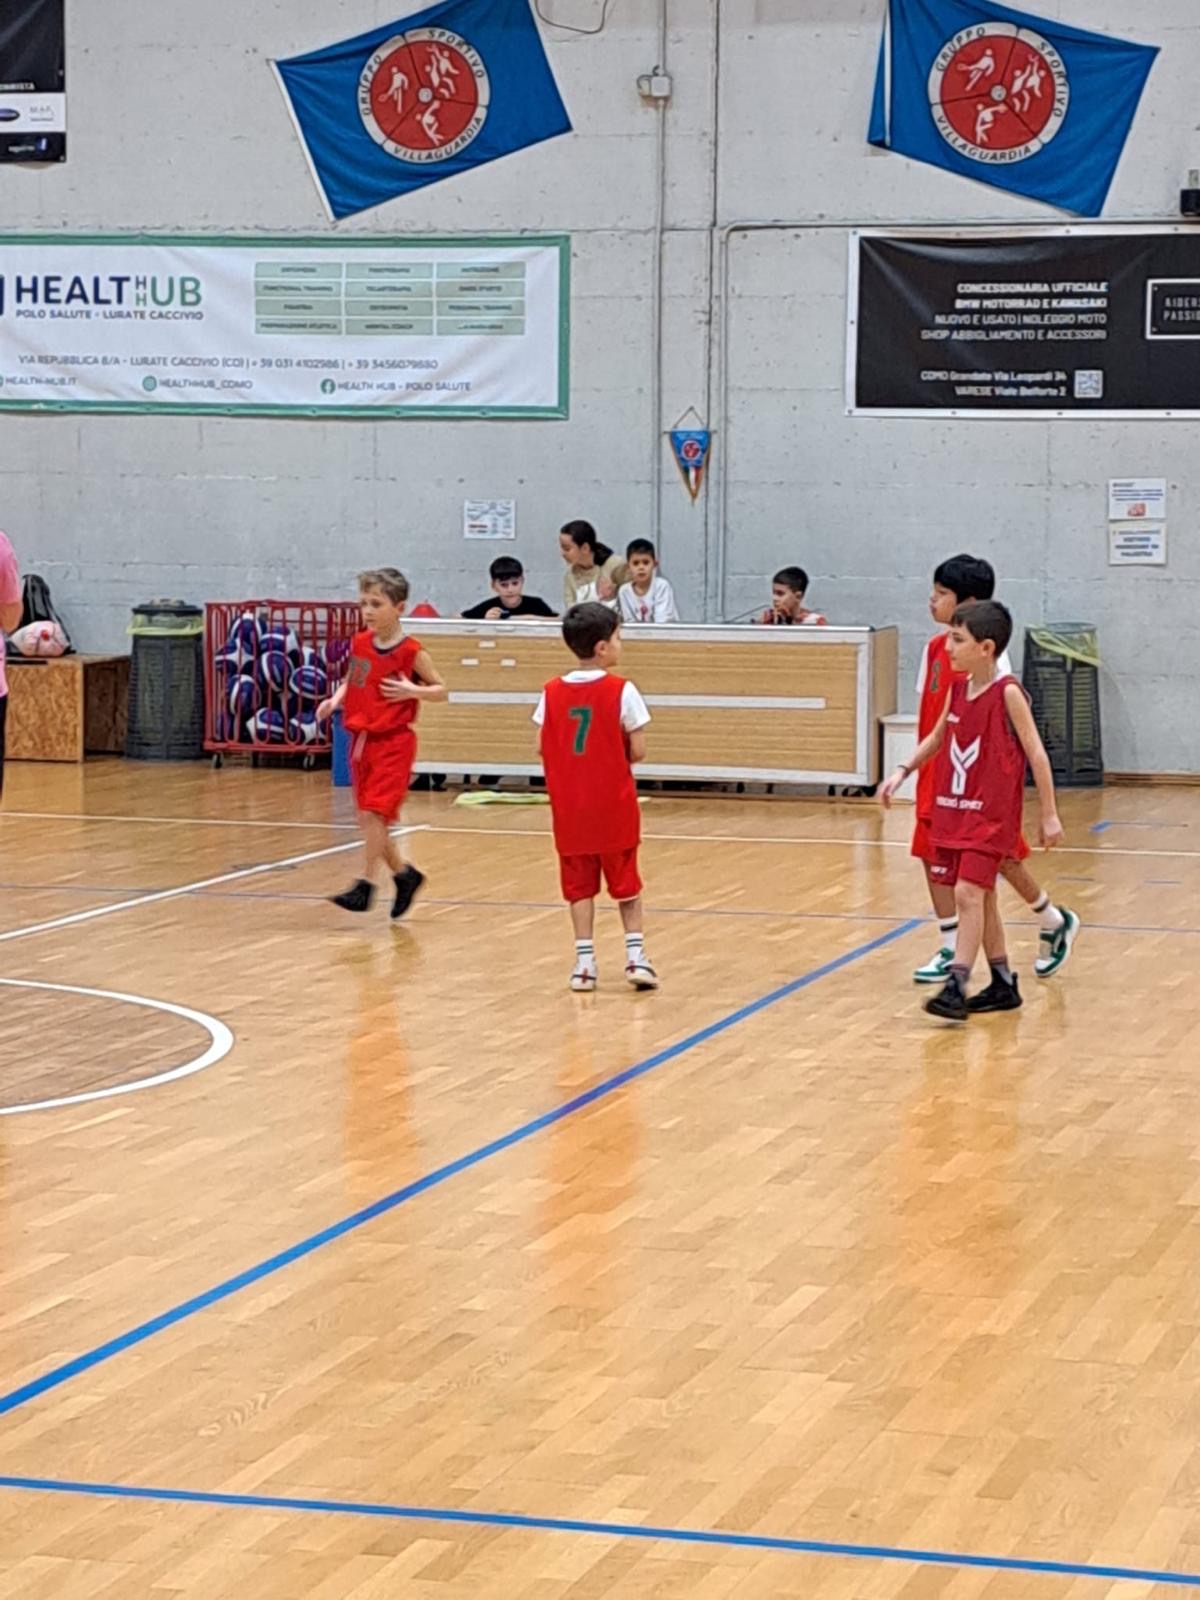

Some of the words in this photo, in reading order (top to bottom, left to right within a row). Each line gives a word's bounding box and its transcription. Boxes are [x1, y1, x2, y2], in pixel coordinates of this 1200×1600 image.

[428, 29, 485, 79] SPORTIVO
[936, 27, 985, 71] GRUPPO
[1038, 41, 1067, 118] SPORTIVO
[393, 116, 483, 161] VILLAGUARDIA
[937, 116, 1032, 161] VILLAGUARDIA
[956, 282, 1050, 294] CONCESSIONARIA
[1051, 282, 1109, 294] UFFICIALE
[954, 298, 980, 310] BMW
[982, 298, 1040, 309] MOTORRAD
[1051, 297, 1108, 309] KAWASAKI
[15, 309, 46, 319] POLO
[49, 309, 92, 320] SALUTE
[102, 311, 146, 320] LURATE
[149, 311, 204, 321] CACCIVIO
[934, 314, 971, 325] NUOVO
[982, 314, 1016, 325] USATO
[1023, 314, 1076, 325] NOLEGGIO
[1077, 314, 1107, 325] MOTO
[920, 330, 950, 340] SHOP
[951, 330, 1035, 341] ABBIGLIAMENTO
[1046, 329, 1107, 340] ACCESSORI
[18, 355, 36, 365] VIA
[37, 355, 99, 365] REPUBBLICA
[130, 356, 168, 366] LURATE
[170, 357, 220, 367] CACCIVIO
[274, 358, 293, 368] 031
[920, 370, 949, 381] COMO
[338, 381, 373, 391] HEALTH
[376, 381, 396, 391] HUB
[405, 382, 433, 391] POLO
[434, 382, 471, 391] SALUTE
[569, 705, 592, 756] 7
